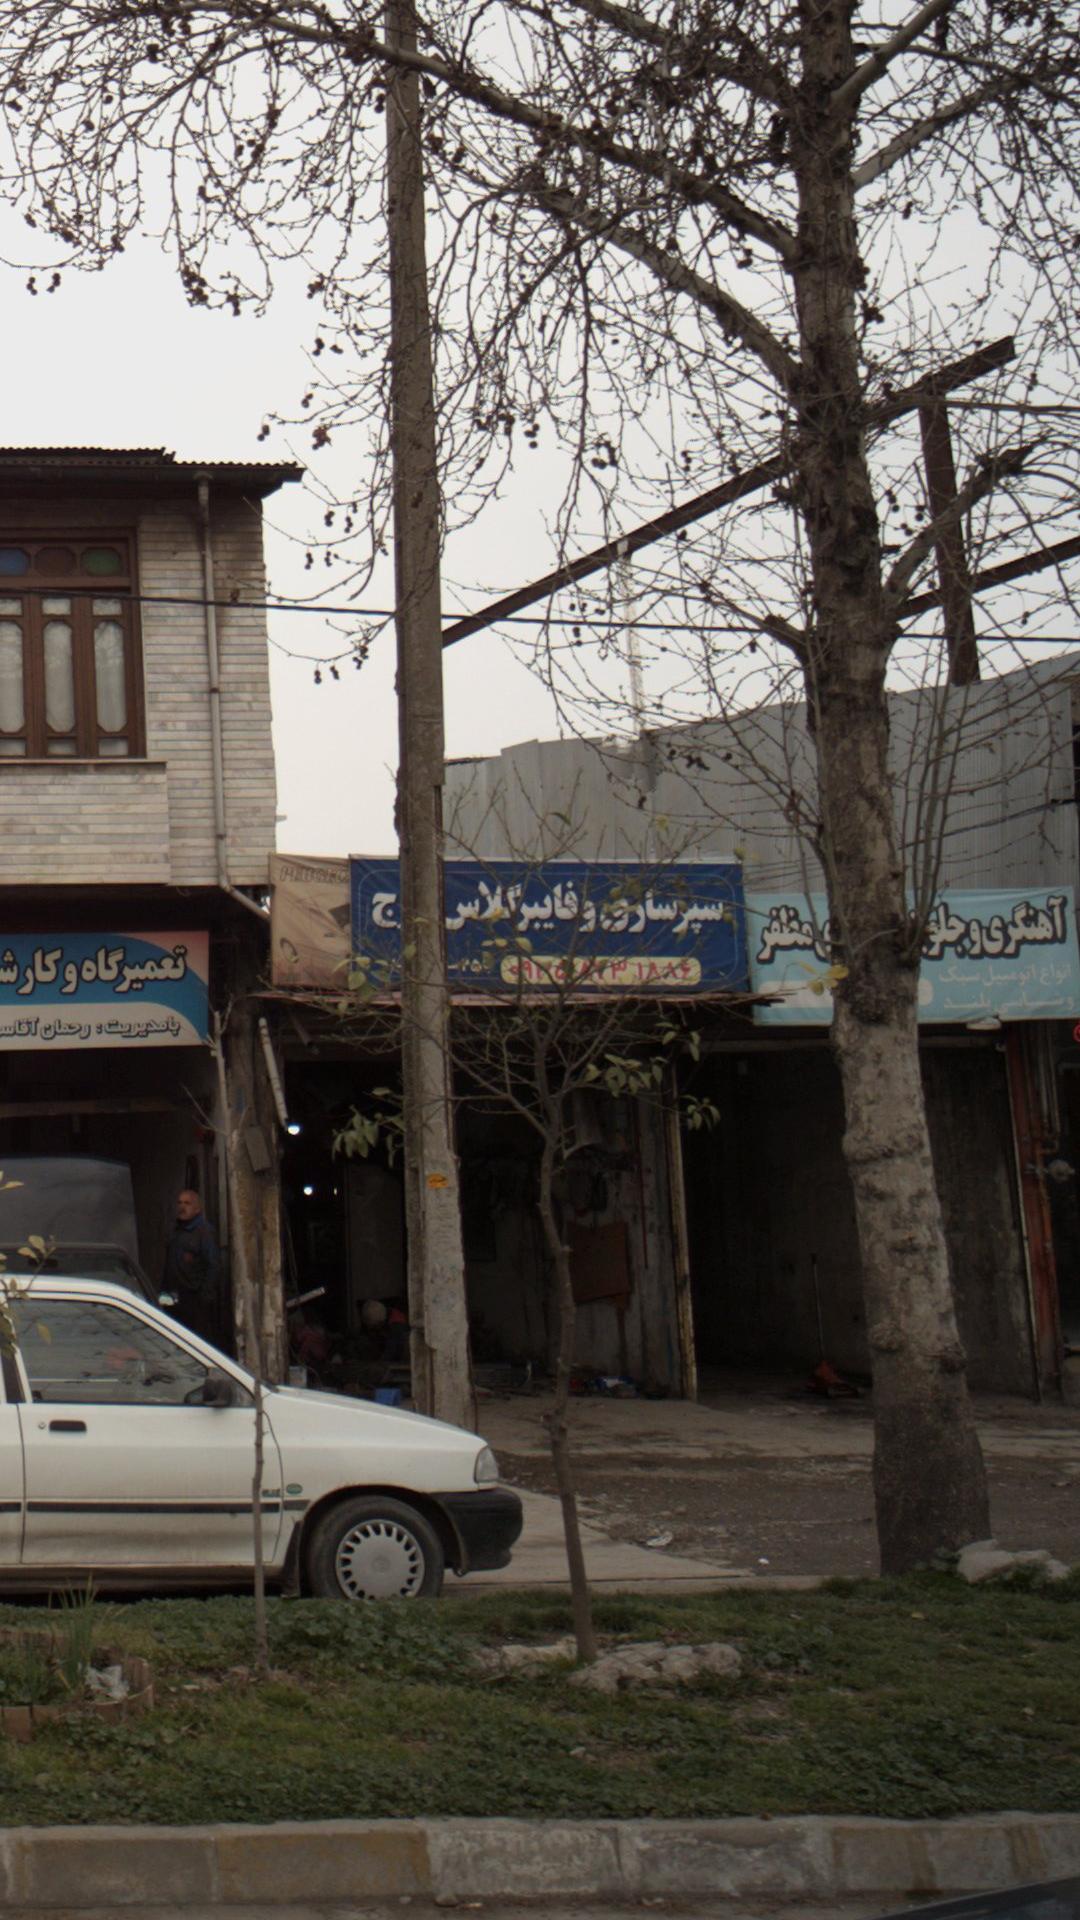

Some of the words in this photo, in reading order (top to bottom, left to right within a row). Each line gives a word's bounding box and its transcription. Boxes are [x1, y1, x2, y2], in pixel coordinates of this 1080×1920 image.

[578, 900, 597, 933] و
[981, 895, 1067, 958] آهنگری
[966, 919, 983, 957] و
[60, 960, 78, 994] و
[81, 944, 187, 993] تعمیرگاه
[938, 965, 981, 987] سبک
[983, 963, 1036, 987] اتومبیل
[1039, 962, 1071, 986] انواع
[40, 1018, 91, 1040] رحمان
